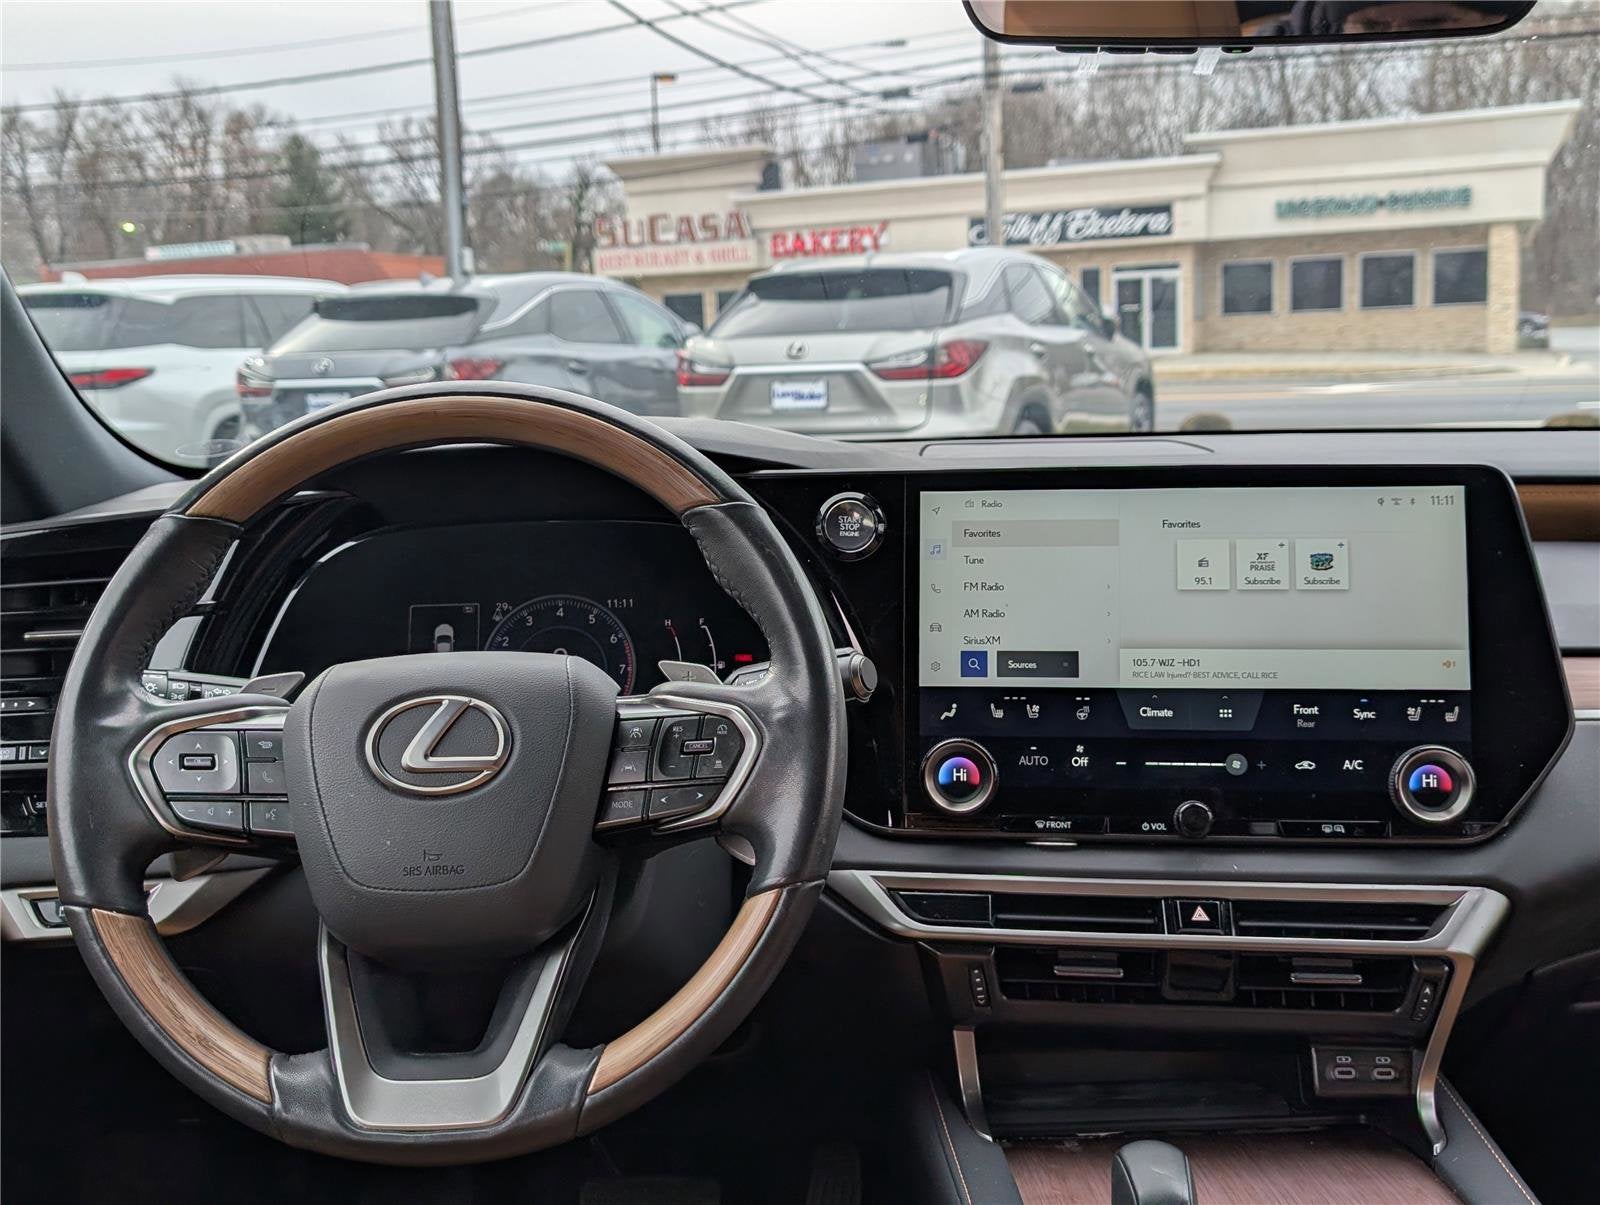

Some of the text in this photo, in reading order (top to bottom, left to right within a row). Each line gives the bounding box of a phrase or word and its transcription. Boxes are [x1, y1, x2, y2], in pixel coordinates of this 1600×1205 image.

[770, 219, 890, 259] BAKERY
[981, 499, 1003, 509] Radio
[1430, 495, 1455, 506] 11:11
[838, 515, 862, 523] START
[1161, 519, 1201, 529] Favorites
[840, 523, 860, 531] STOP
[963, 528, 1001, 539] Favorites
[963, 555, 984, 565] Tune
[1194, 576, 1213, 585] 95.1
[1244, 576, 1281, 585] Subscribe
[1303, 576, 1341, 585] Subscribe
[963, 581, 1005, 592] FM Radio
[606, 599, 634, 608] 11:11
[556, 607, 564, 617] 4
[963, 608, 1005, 618] AM Radio
[525, 616, 533, 626] 3
[588, 614, 596, 624] 5
[699, 617, 705, 625] F
[502, 636, 510, 647] 2
[610, 633, 618, 644] 6
[963, 635, 1001, 645] SiriusXM
[1007, 660, 1037, 669] Sources
[1132, 658, 1156, 667] 105.7
[1158, 658, 1175, 667] WJZ
[619, 664, 626, 674] 7
[1132, 671, 1149, 679] RICE
[1150, 671, 1165, 679] LAW
[1193, 671, 1211, 679] BEST
[1241, 671, 1260, 679] CALL
[1261, 671, 1278, 679] RICE
[1139, 707, 1174, 718] Climate
[1293, 704, 1320, 715] Front
[1353, 708, 1376, 720] Sync
[1297, 719, 1315, 728] Rear
[1018, 755, 1049, 766] AUTO
[1071, 756, 1089, 767] Off
[1343, 759, 1364, 770] A/C
[953, 768, 967, 782] Hi
[1421, 774, 1438, 789] Hi
[611, 801, 633, 809] MODE
[1046, 820, 1072, 829] FRONT
[1150, 822, 1167, 831] VOL
[402, 864, 465, 877] SRS AIRBAG
